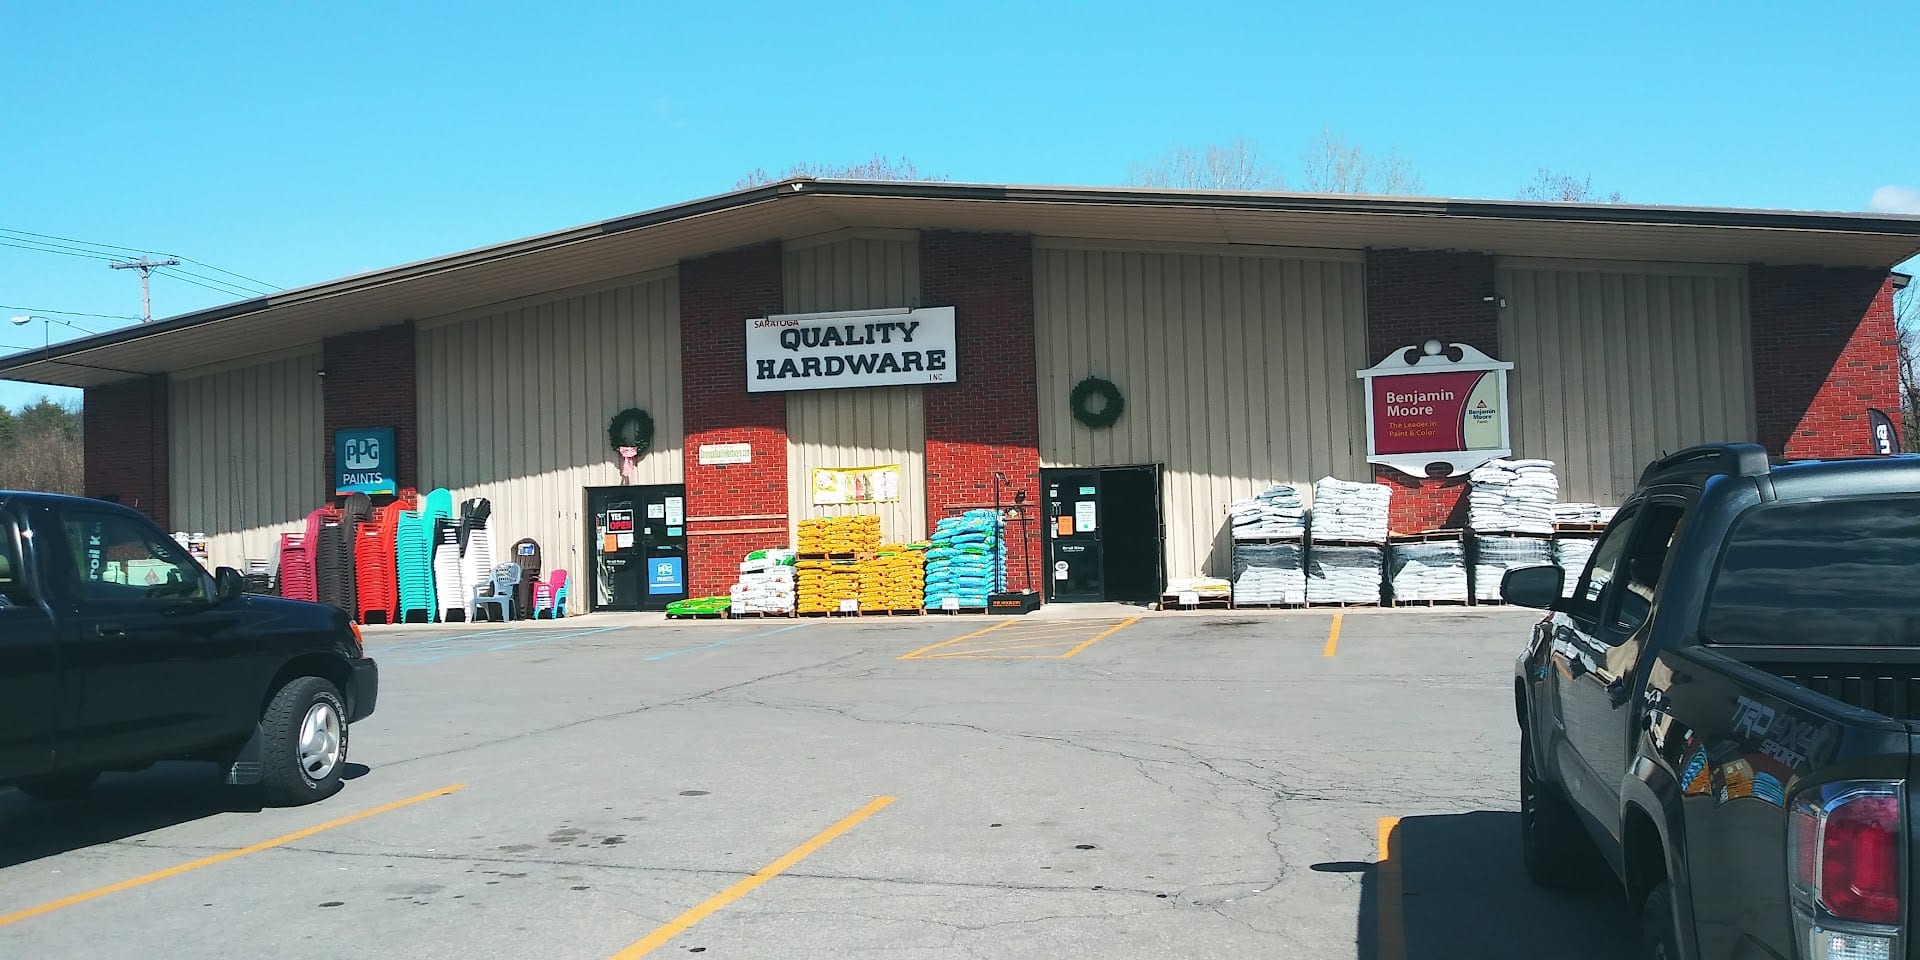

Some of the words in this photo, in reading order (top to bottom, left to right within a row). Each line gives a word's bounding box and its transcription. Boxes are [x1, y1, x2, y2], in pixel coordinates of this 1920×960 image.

[754, 319, 800, 329] SARATOGA
[780, 321, 919, 351] QUALITY
[756, 350, 946, 380] HARDWARE
[1386, 388, 1454, 405] Benjamin
[1387, 405, 1433, 417] Moore
[346, 439, 378, 464] PPG
[342, 472, 383, 485] PAINTS
[89, 548, 101, 580] roil
[1731, 694, 1776, 738] TRD
[1758, 738, 1807, 770] SPORT
